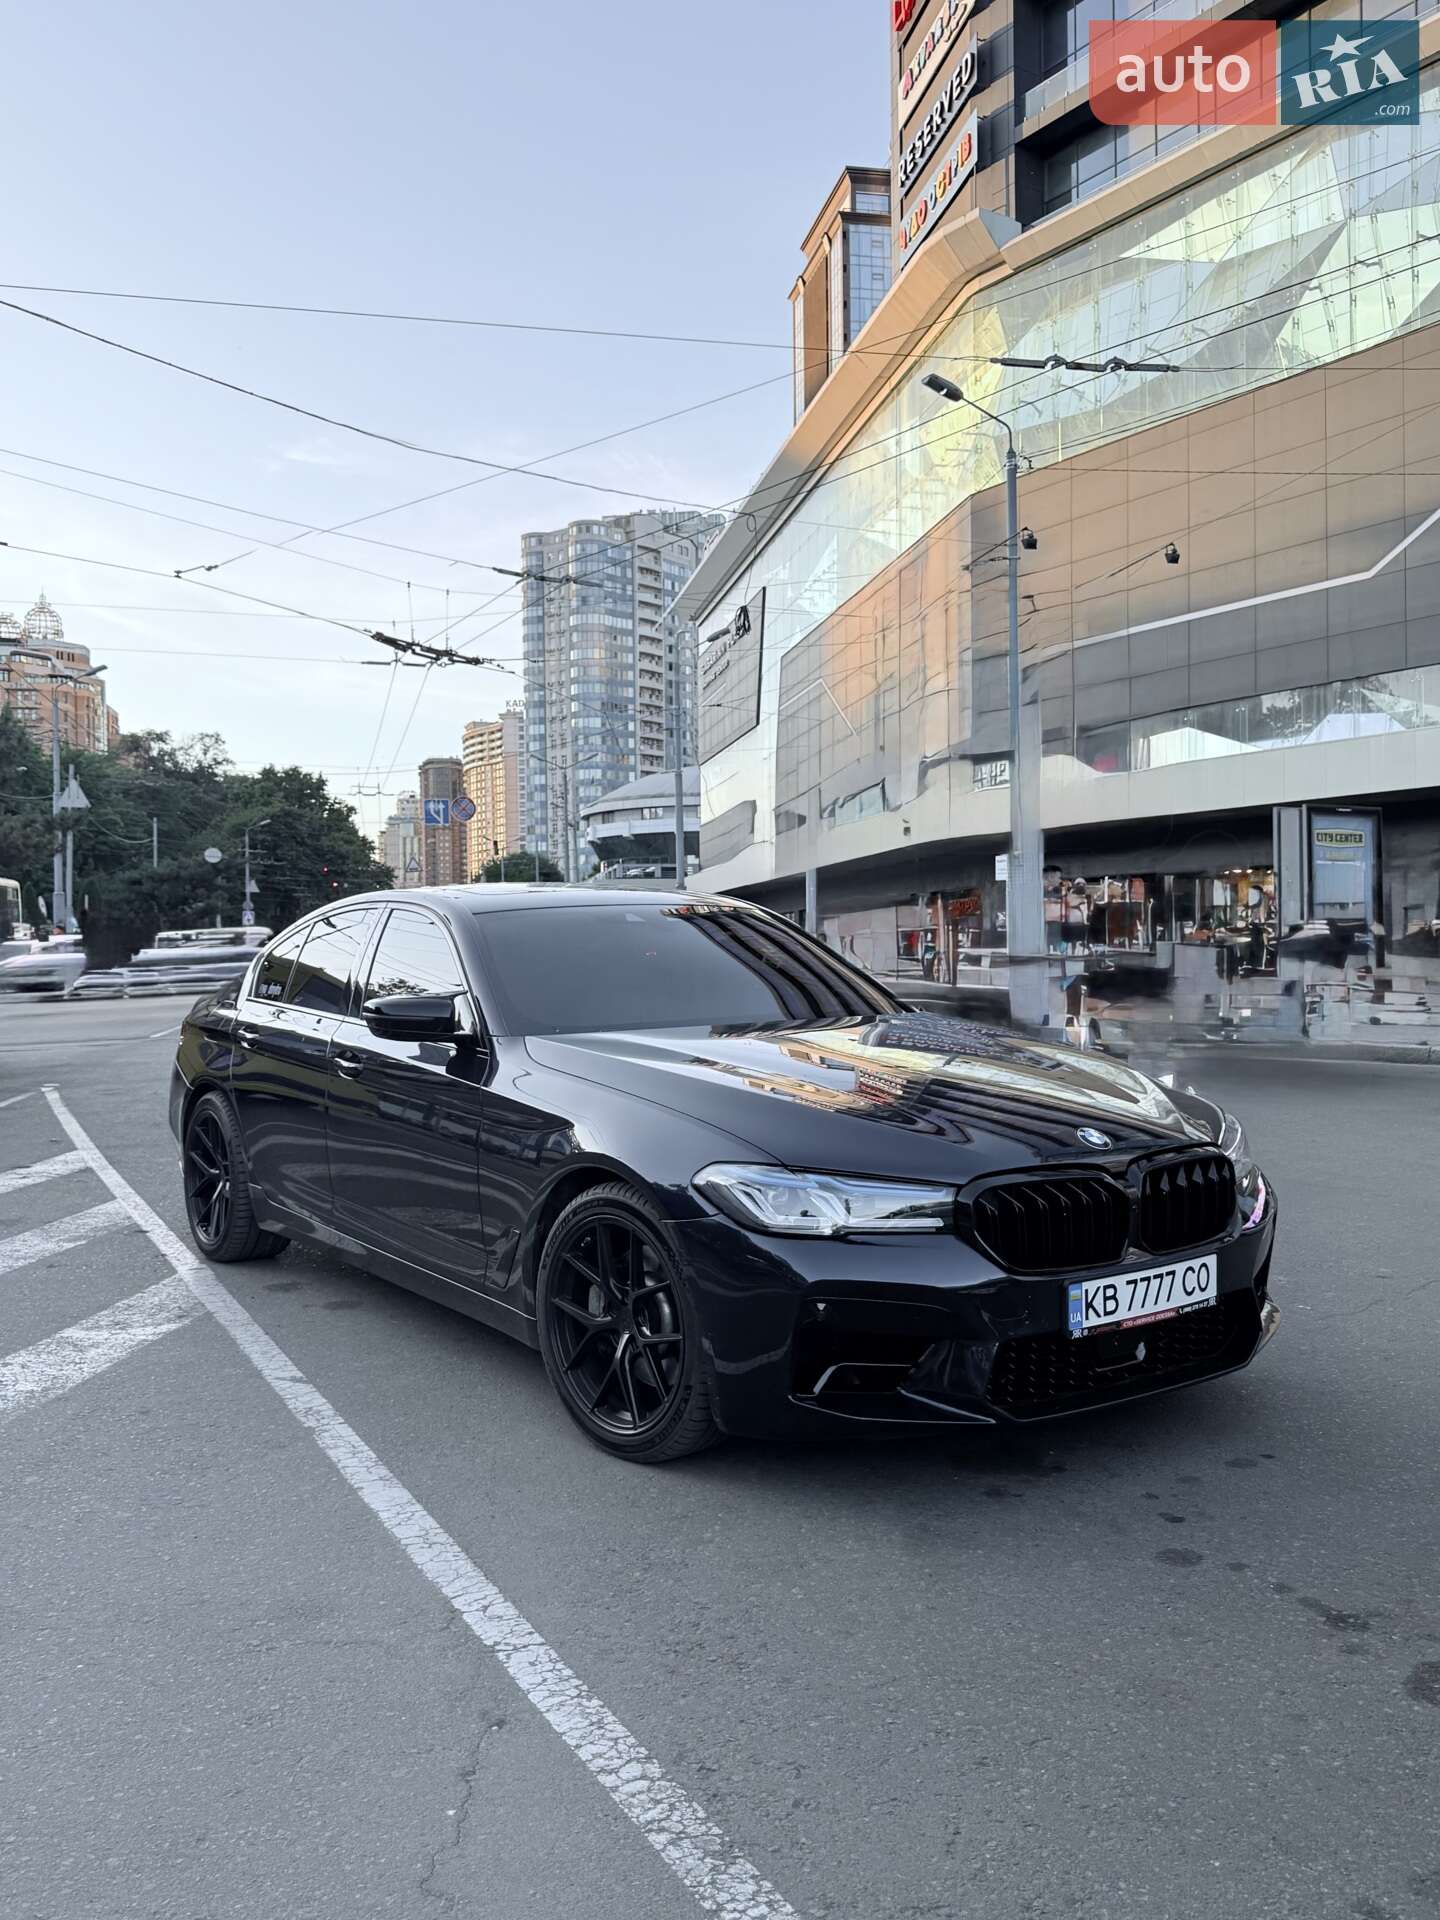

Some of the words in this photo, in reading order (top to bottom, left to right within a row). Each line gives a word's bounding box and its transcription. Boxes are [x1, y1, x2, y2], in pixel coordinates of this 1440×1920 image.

[899, 52, 974, 187] RESERVED
[1316, 832, 1333, 842] CITY
[1335, 833, 1363, 843] CENTER
[1084, 1283, 1119, 1321] KB
[1125, 1269, 1176, 1312] 7777
[1182, 1262, 1210, 1297] CO
[1070, 1312, 1082, 1324] UA
